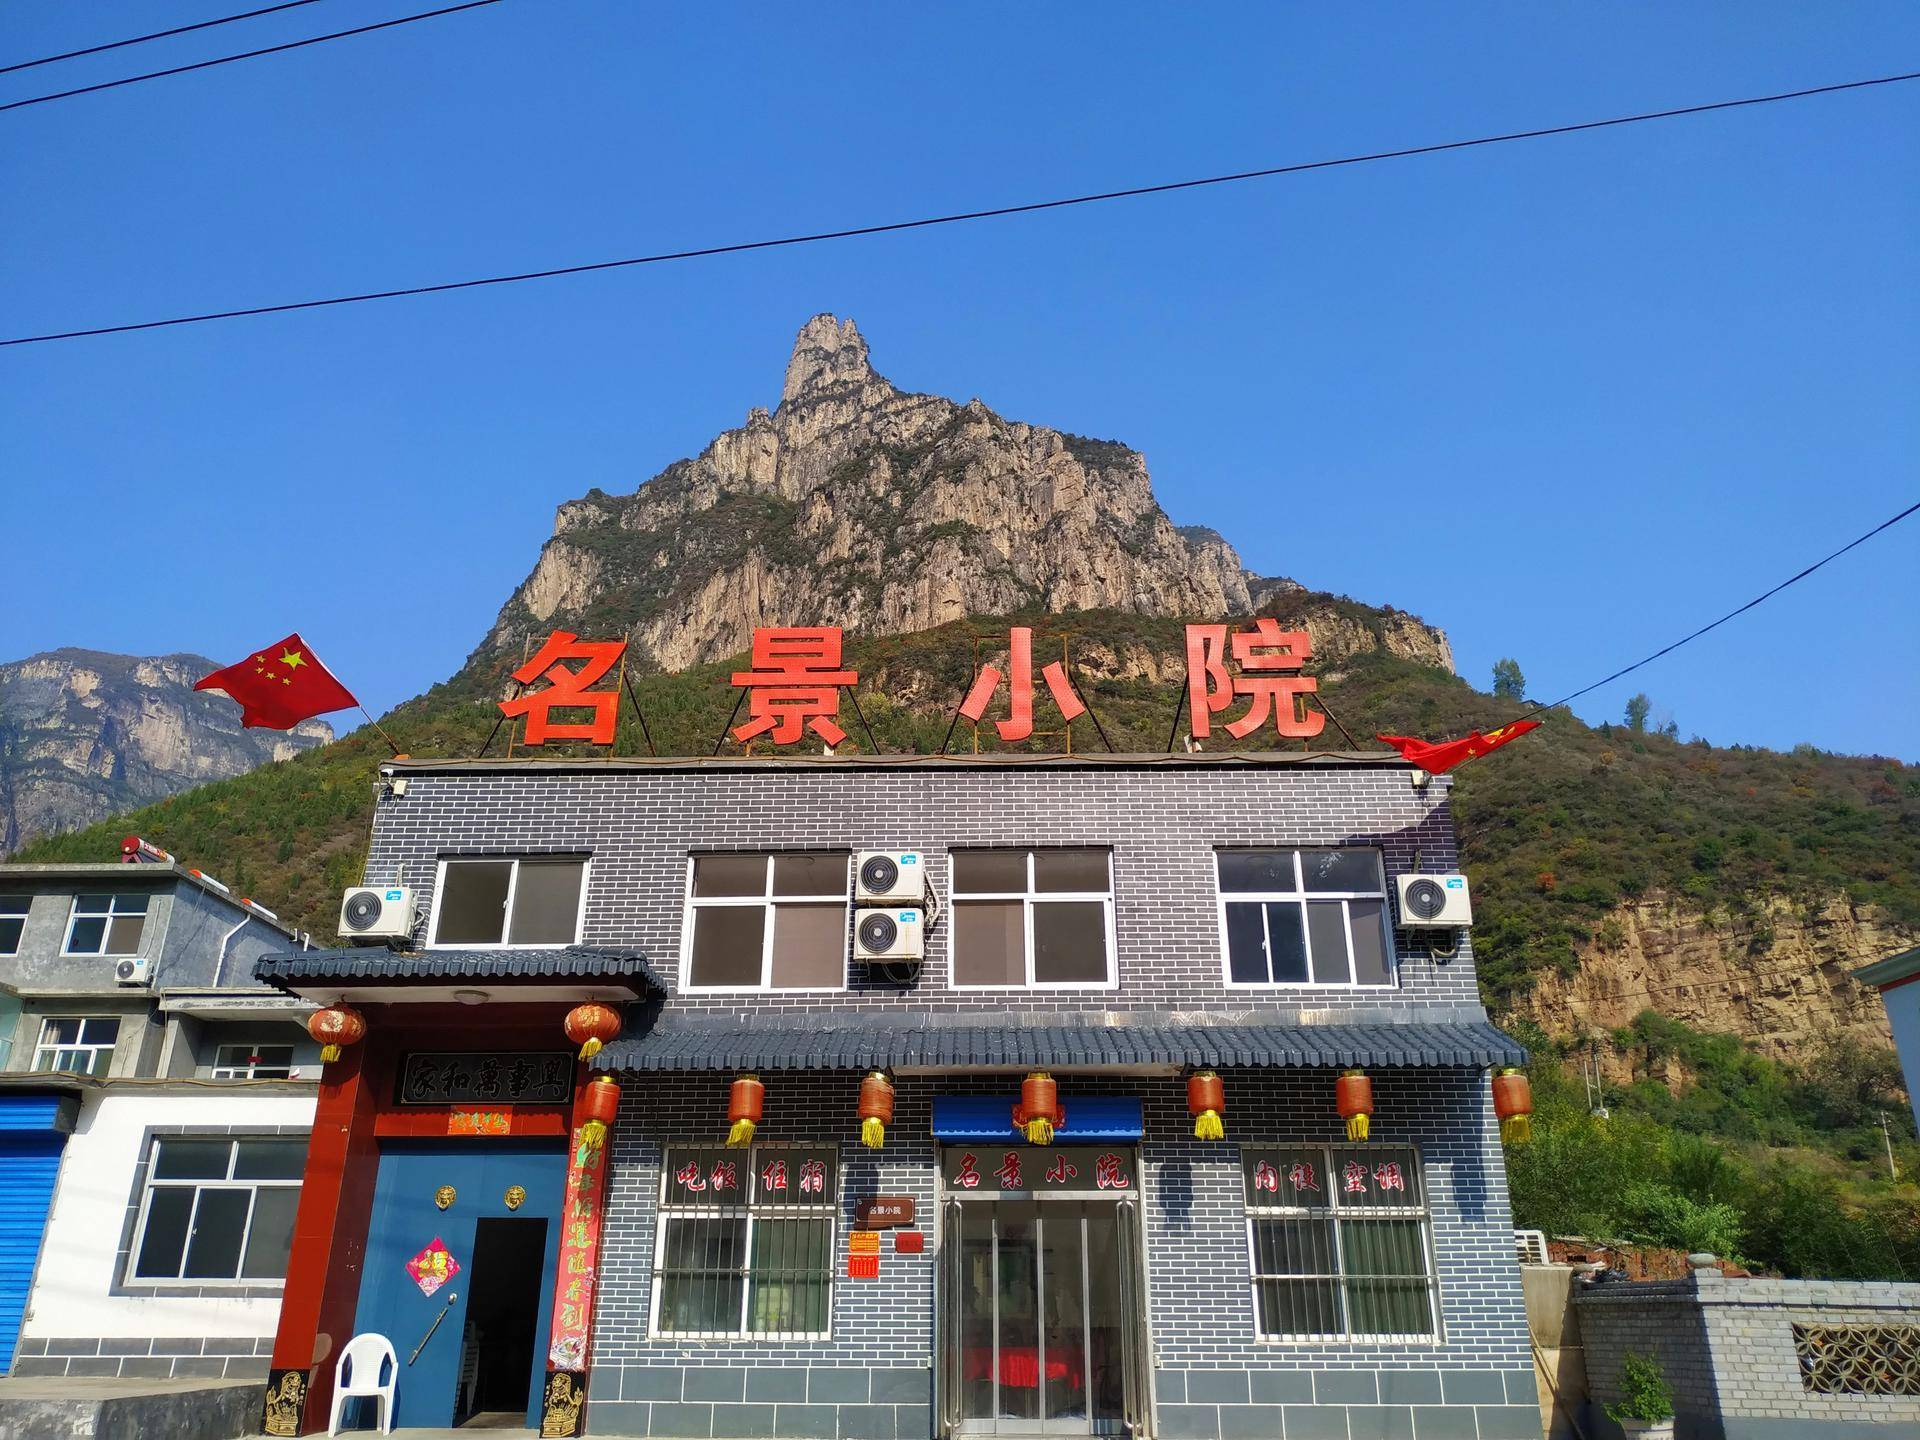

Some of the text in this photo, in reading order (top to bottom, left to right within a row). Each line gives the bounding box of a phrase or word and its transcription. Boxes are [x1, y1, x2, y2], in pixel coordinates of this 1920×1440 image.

[498, 618, 1326, 746] 名景小院
[675, 1159, 825, 1192] 吃饭 住宿
[954, 1151, 1130, 1189] 名景小院
[1255, 1159, 1405, 1193] 内设 空调
